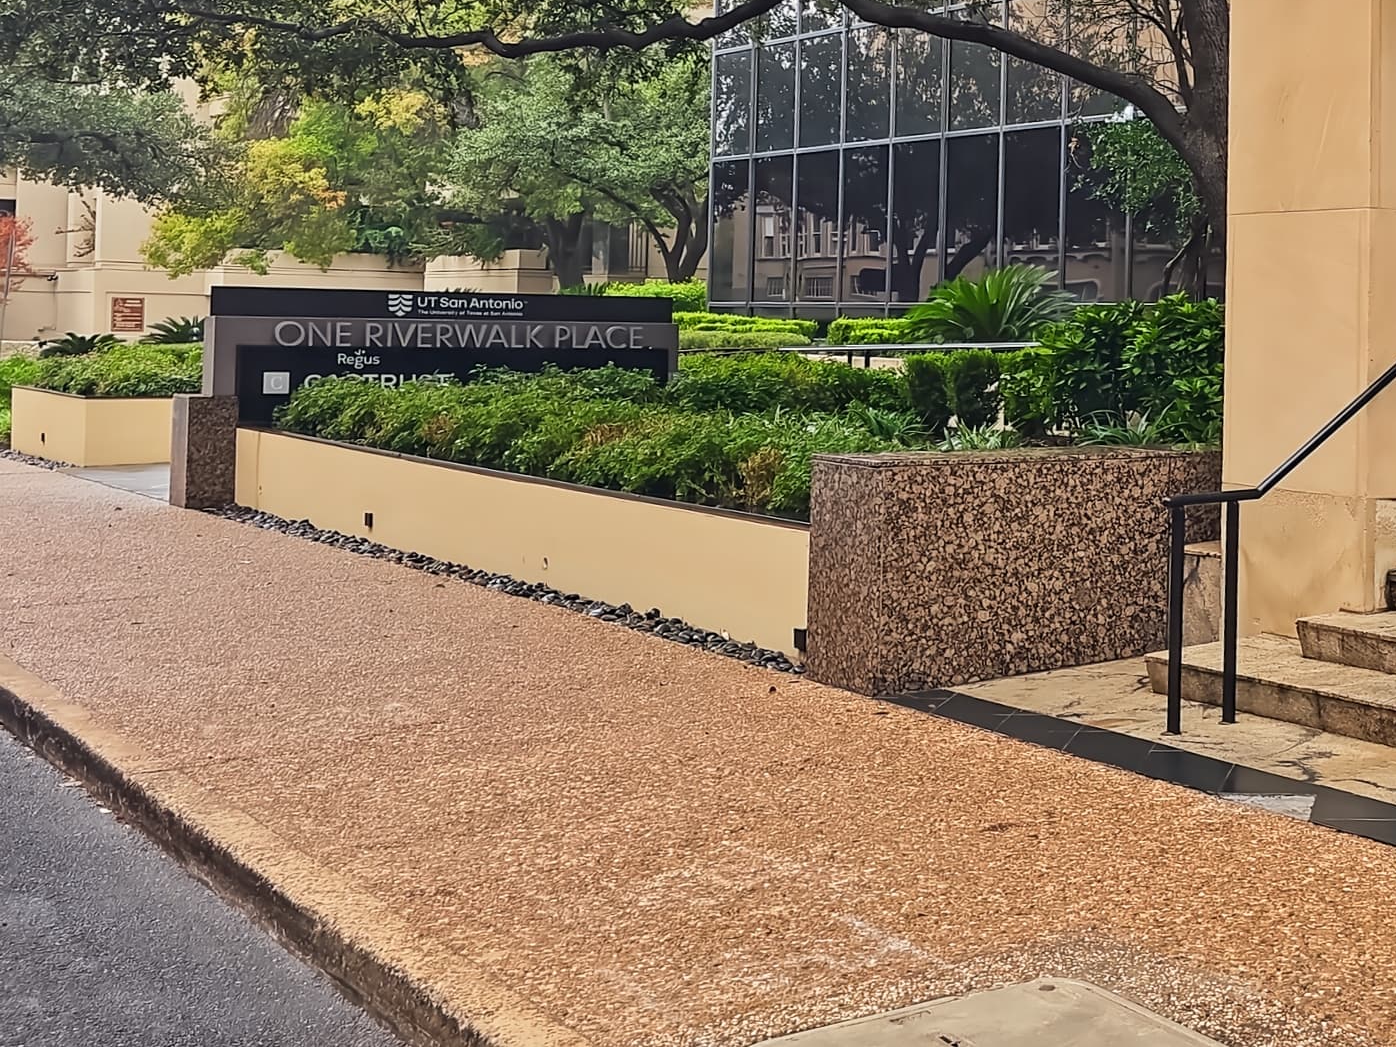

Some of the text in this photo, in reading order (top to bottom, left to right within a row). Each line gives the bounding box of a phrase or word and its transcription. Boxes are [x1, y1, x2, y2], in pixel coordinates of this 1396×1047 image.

[417, 296, 523, 310] UT San Antonio
[274, 320, 643, 349] ONE RIVERWALK PLACE
[337, 350, 381, 370] Regus
